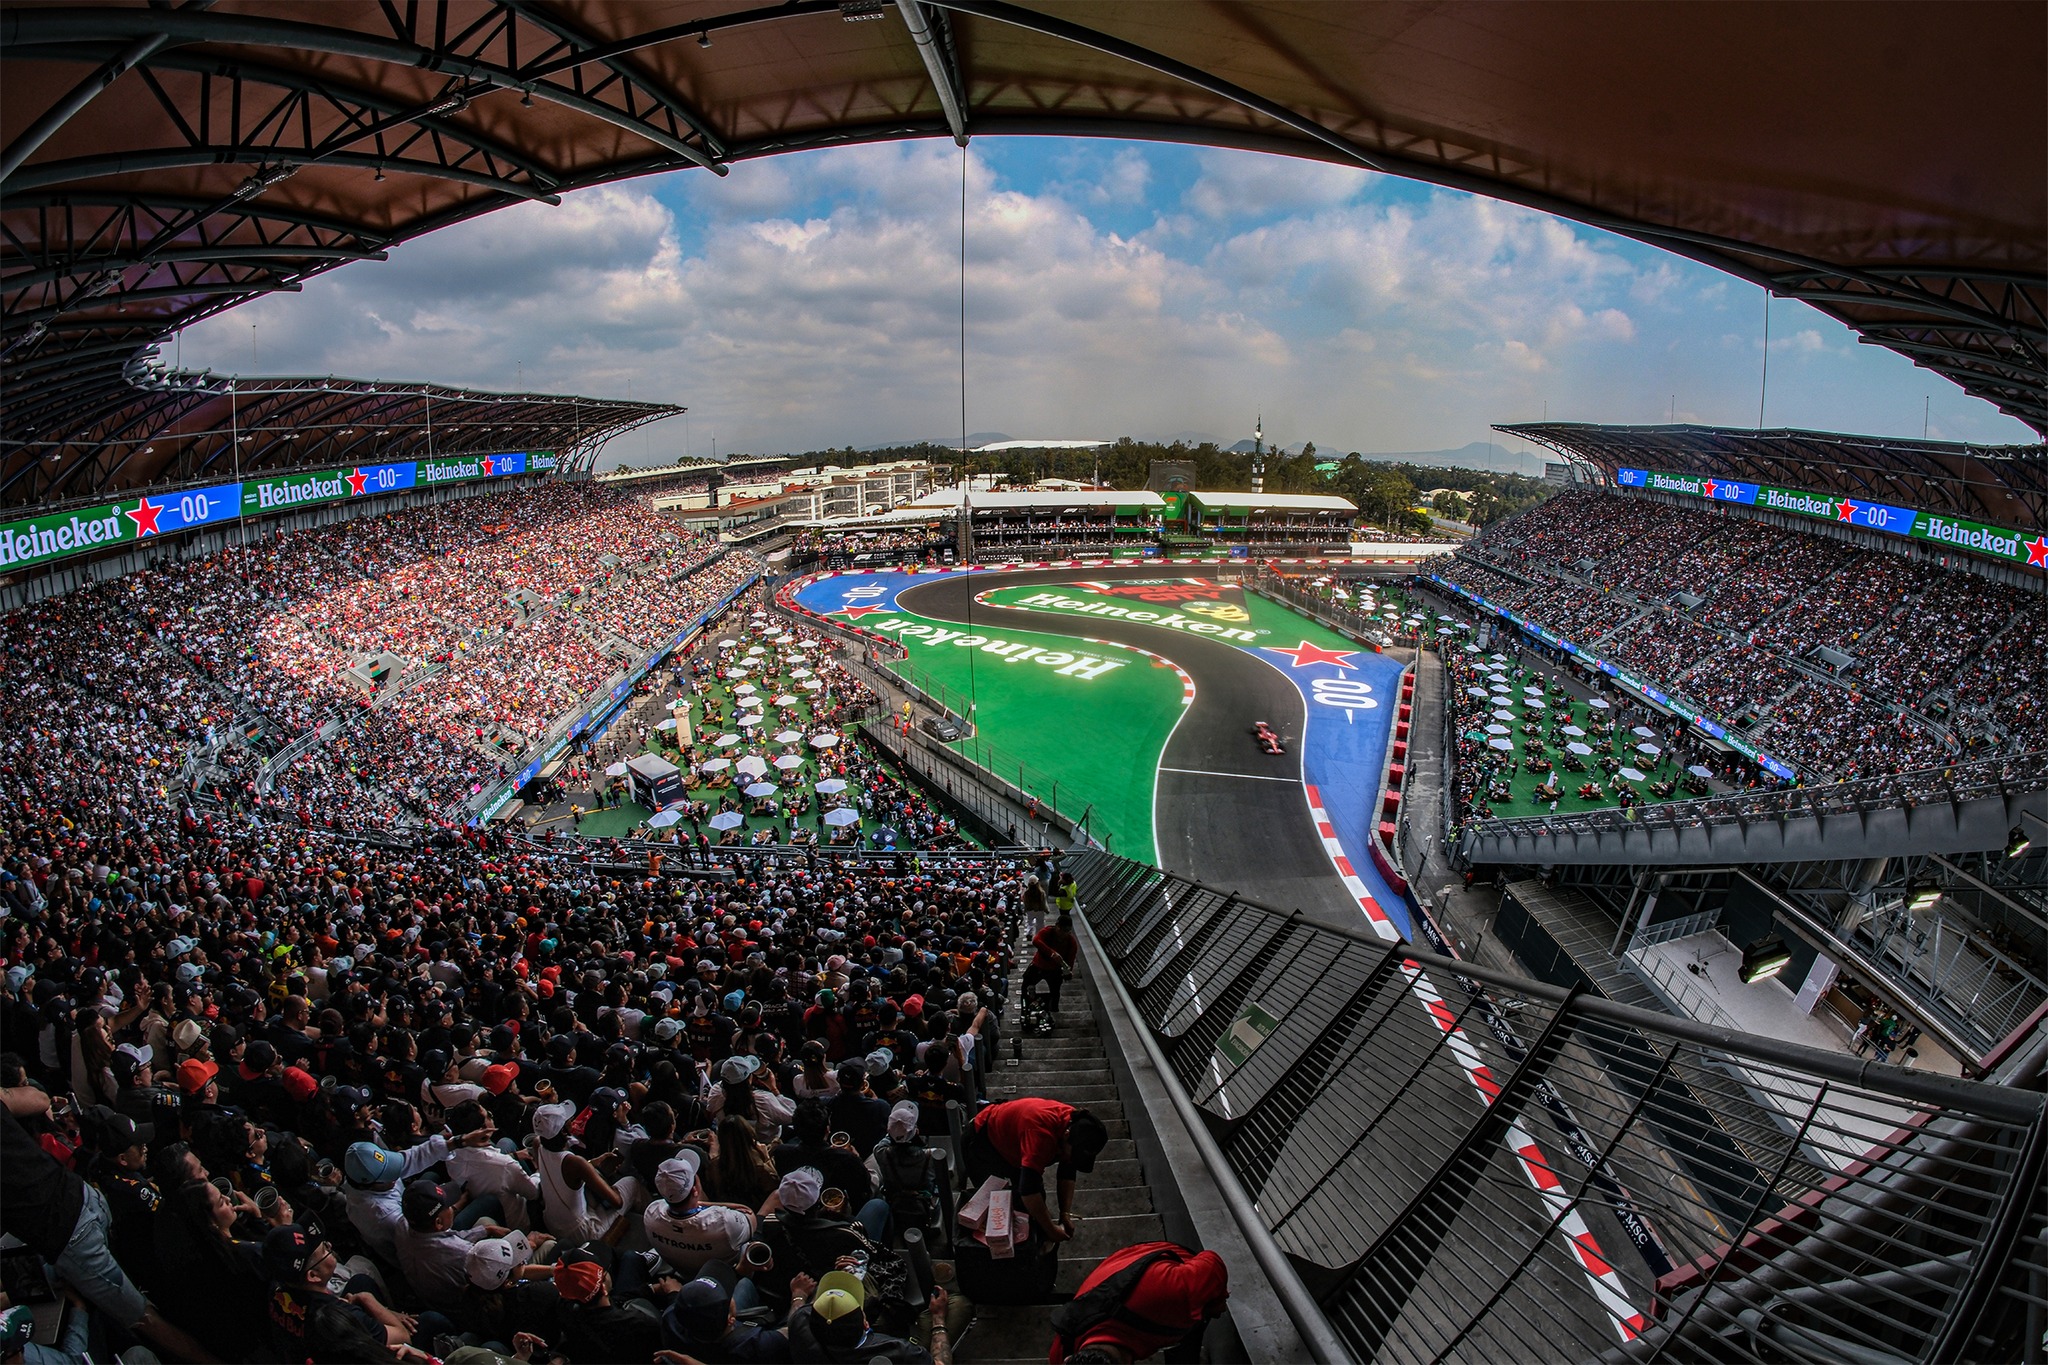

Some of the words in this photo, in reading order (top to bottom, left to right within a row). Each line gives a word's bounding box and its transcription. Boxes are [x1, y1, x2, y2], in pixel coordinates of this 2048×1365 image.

[425, 459, 479, 482] Heineken
[257, 476, 344, 509] Heineken
[1766, 489, 1832, 517] Heineken
[1926, 517, 2018, 557] Heineken
[1139, 591, 1221, 601] CITY
[1016, 592, 1258, 643] Heineken
[874, 617, 1127, 681] Heineken
[652, 1231, 713, 1251] PETRONAS
[1624, 1212, 1648, 1245] MSC
